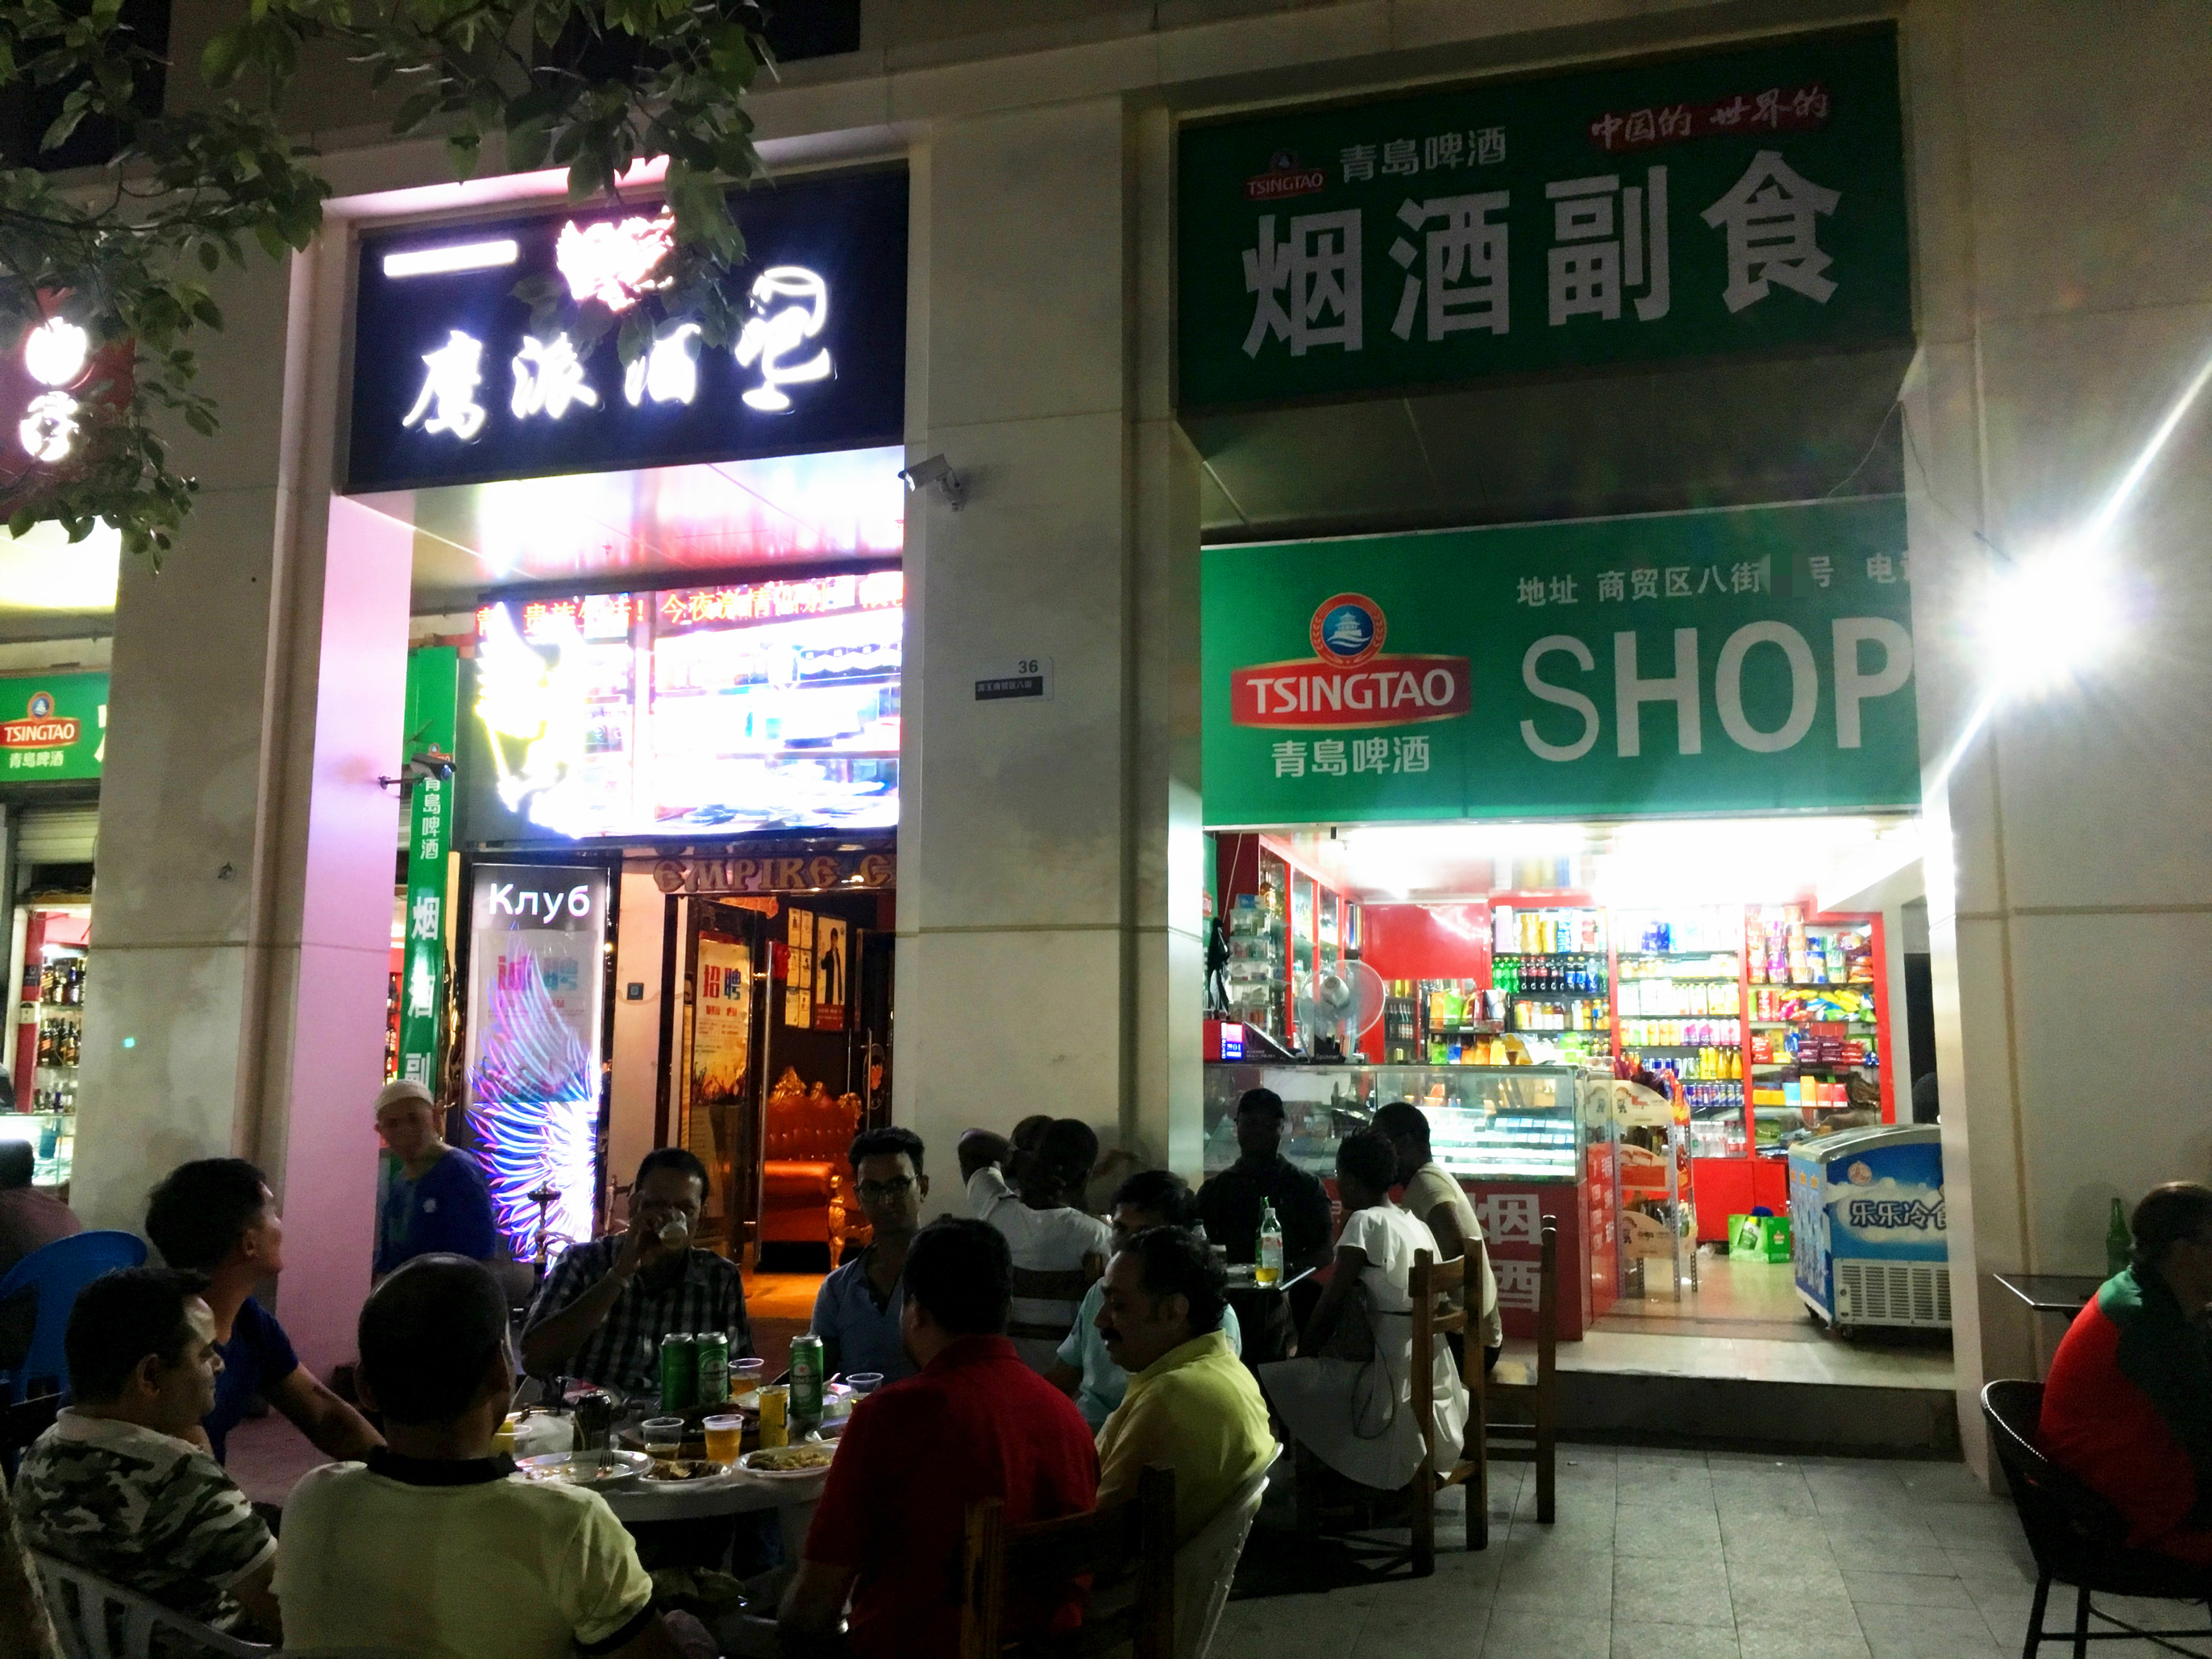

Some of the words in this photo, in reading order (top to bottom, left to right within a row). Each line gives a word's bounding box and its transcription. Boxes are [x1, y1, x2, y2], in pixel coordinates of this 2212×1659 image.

[1591, 105, 1692, 149] 中国的
[1708, 86, 1830, 128] 世界的
[1339, 126, 1505, 183] 青島啤酒
[1246, 173, 1323, 196] TSINGTAO
[1240, 149, 1844, 360] 烟酒副食
[1517, 573, 1579, 607] 地址
[1596, 561, 1761, 602] 商贸区八街
[1019, 659, 1038, 674] 36
[1246, 667, 1455, 715] TSINGTAO
[1519, 617, 1914, 763] SHOP
[4, 723, 75, 743] TSINGTAO
[1272, 735, 1430, 778] 青島啤酒
[653, 855, 839, 892] EMPIRE
[489, 883, 590, 924] Клуб
